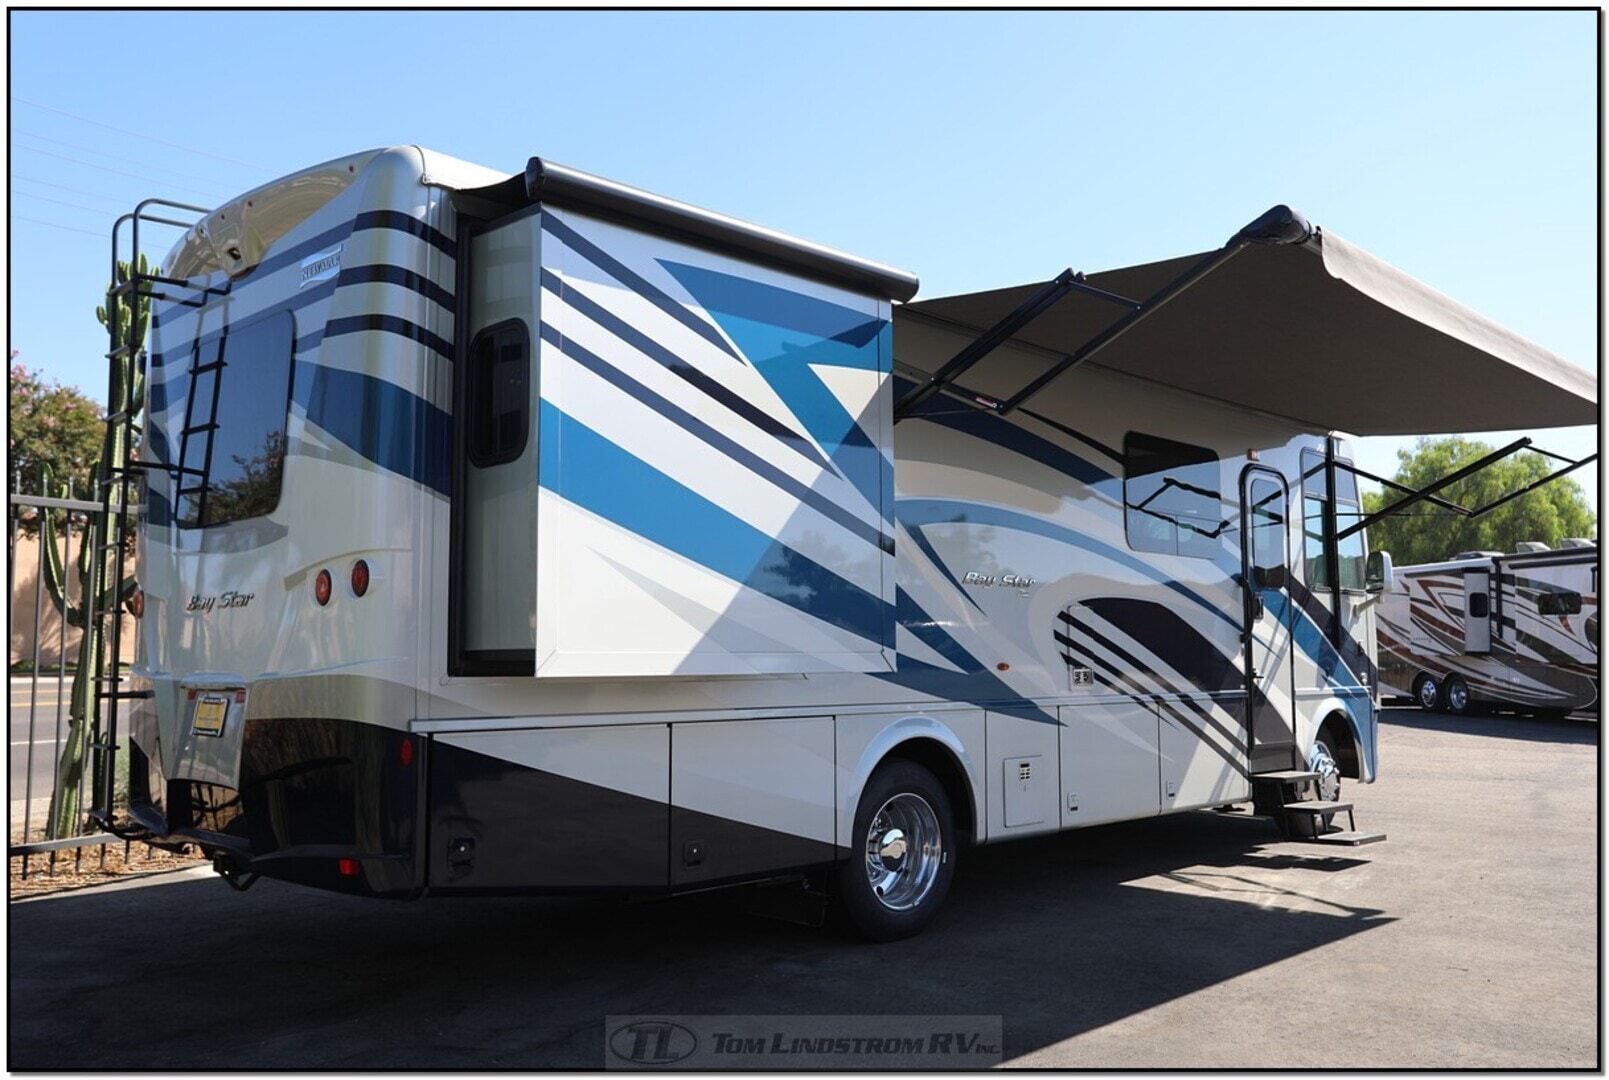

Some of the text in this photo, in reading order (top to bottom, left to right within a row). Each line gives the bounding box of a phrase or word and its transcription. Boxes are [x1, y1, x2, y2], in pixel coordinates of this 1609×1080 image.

[962, 571, 1036, 589] Bay Star
[186, 591, 254, 613] Bay Star
